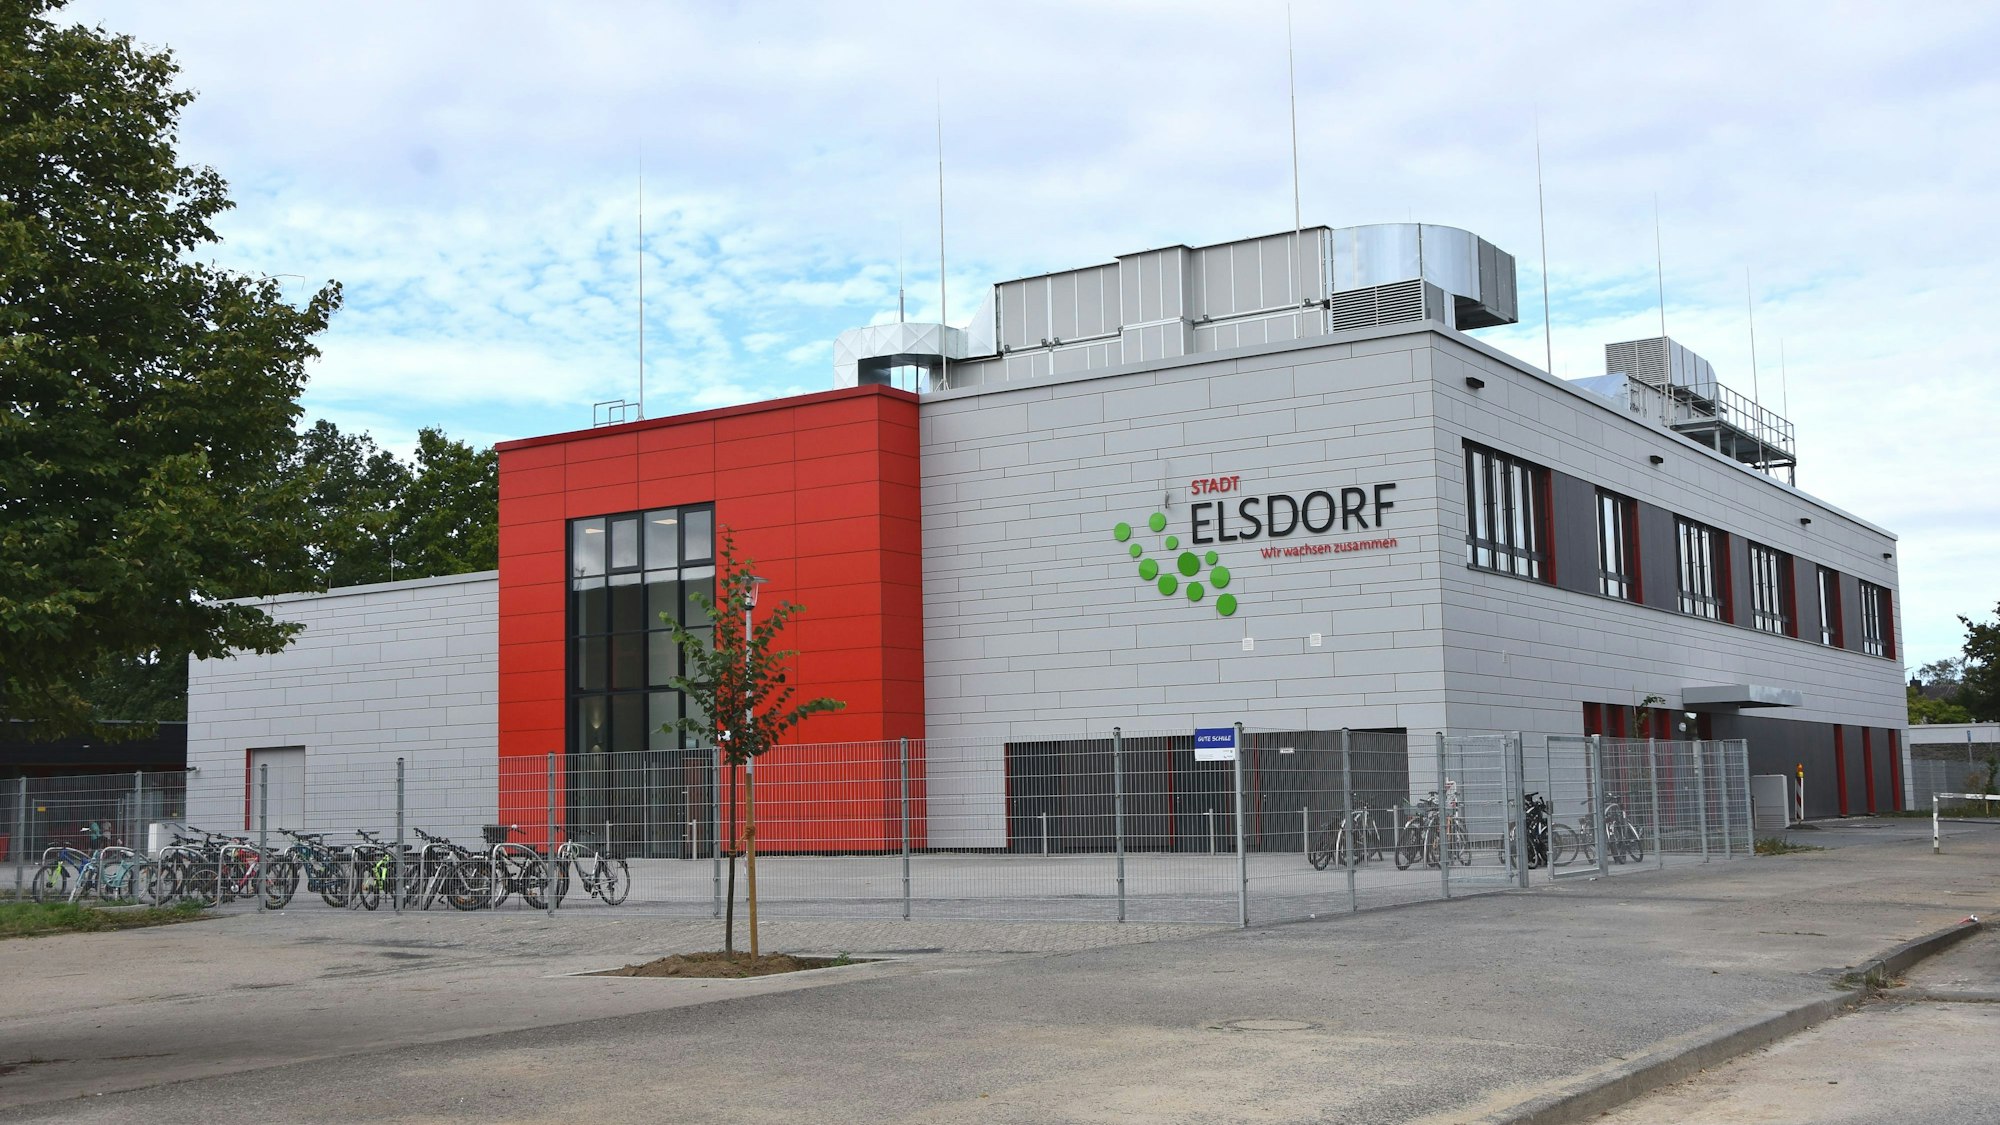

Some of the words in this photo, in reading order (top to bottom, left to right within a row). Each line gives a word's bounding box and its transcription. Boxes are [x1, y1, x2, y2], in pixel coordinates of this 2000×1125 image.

[1191, 476, 1240, 495] STADT
[1191, 482, 1396, 544] ELSDORF
[1260, 547, 1281, 559] Wir
[1283, 543, 1331, 557] wachsen
[1333, 538, 1397, 554] zusammen
